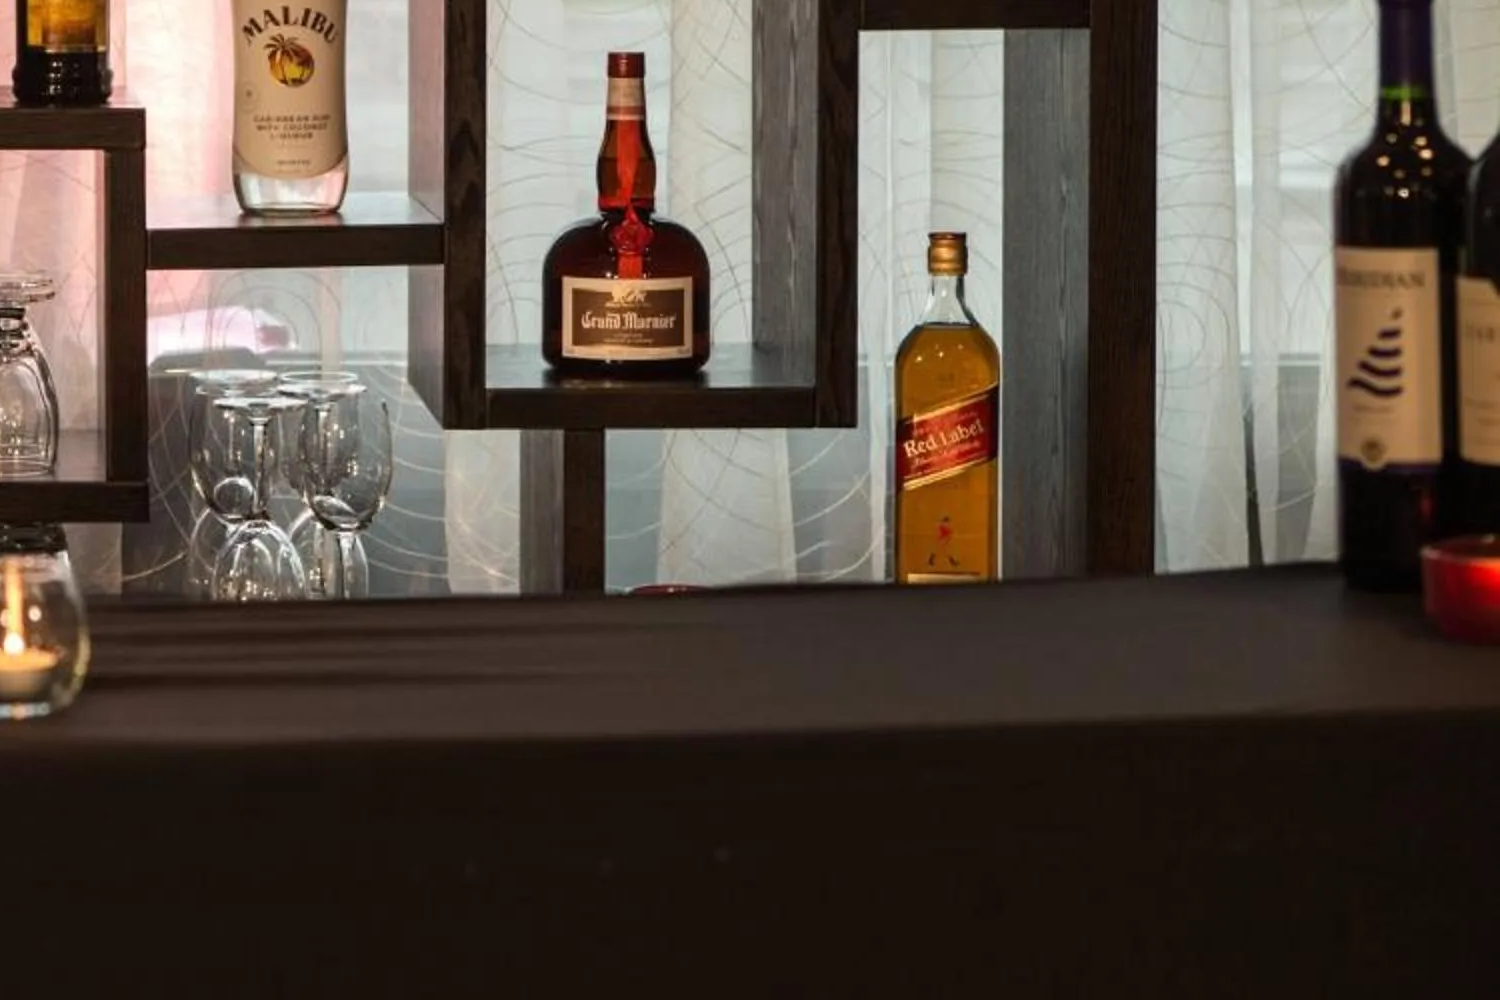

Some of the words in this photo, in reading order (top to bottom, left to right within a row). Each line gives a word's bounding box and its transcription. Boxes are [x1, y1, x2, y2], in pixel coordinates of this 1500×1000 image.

[242, 5, 339, 46] MALIBU
[581, 310, 621, 330] Grand
[622, 310, 677, 330] Marnier
[904, 433, 938, 458] Red
[939, 418, 984, 447] Label
